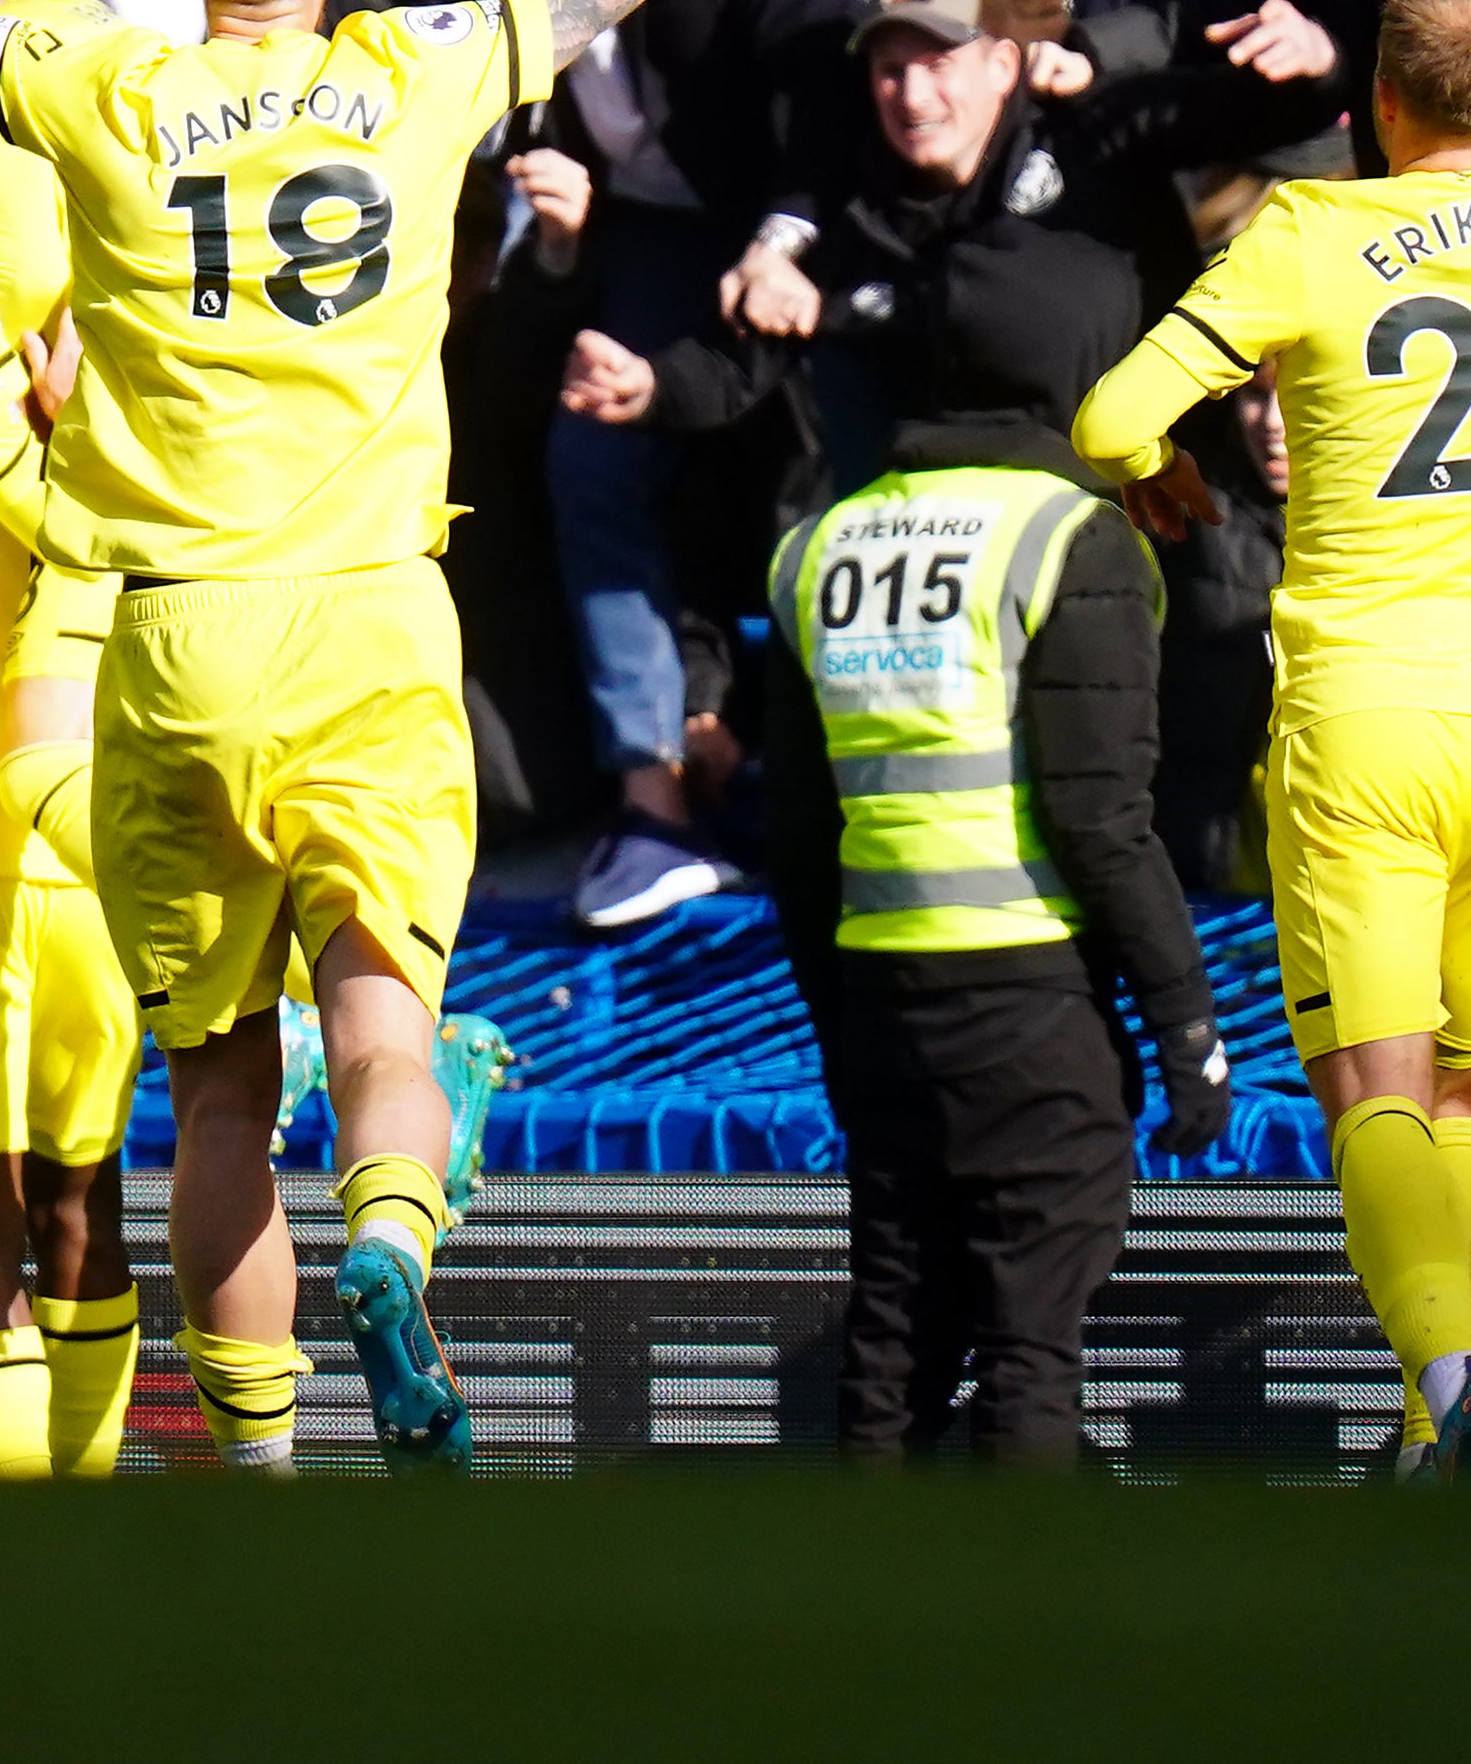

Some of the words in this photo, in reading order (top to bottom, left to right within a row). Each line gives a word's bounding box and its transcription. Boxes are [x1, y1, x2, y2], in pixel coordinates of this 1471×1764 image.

[166, 164, 392, 327] 18
[837, 517, 983, 542] STEWARD
[821, 551, 971, 629] 015
[826, 645, 943, 675] servoca
